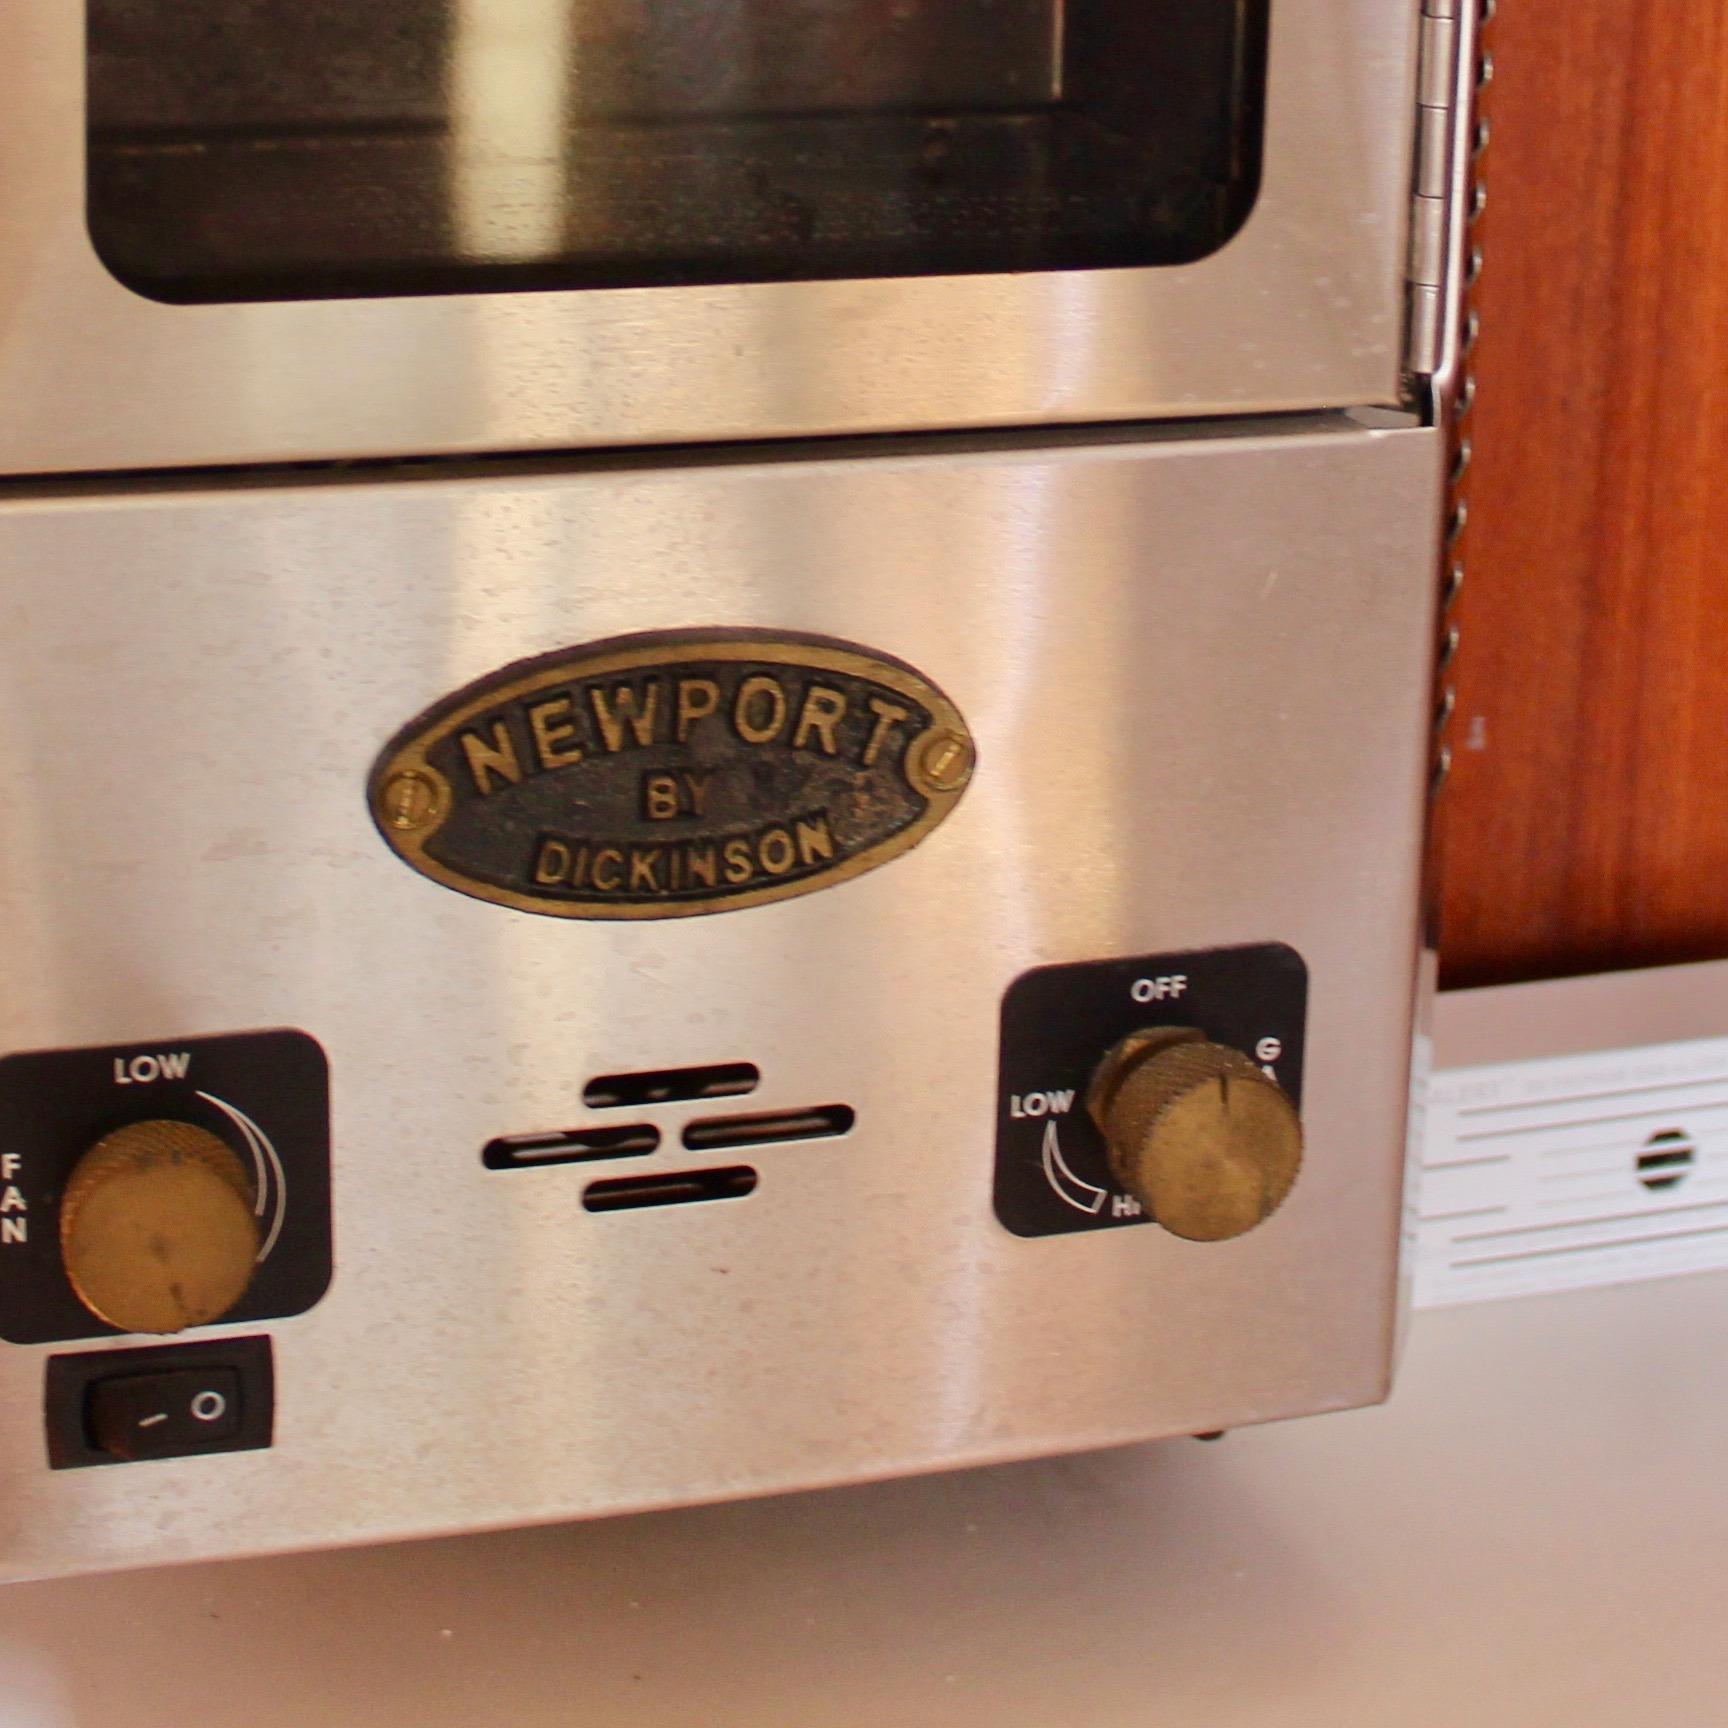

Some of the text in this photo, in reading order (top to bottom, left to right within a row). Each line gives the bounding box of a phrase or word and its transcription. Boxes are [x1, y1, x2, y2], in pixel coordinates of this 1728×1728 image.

[460, 675, 907, 795] NEWPORT
[645, 775, 709, 819] BY
[532, 810, 835, 891] DICKINSON
[1131, 975, 1187, 1002] OFF
[114, 1053, 191, 1084] LOW
[1010, 1090, 1074, 1118] LOW
[0, 1153, 27, 1244] FAN
